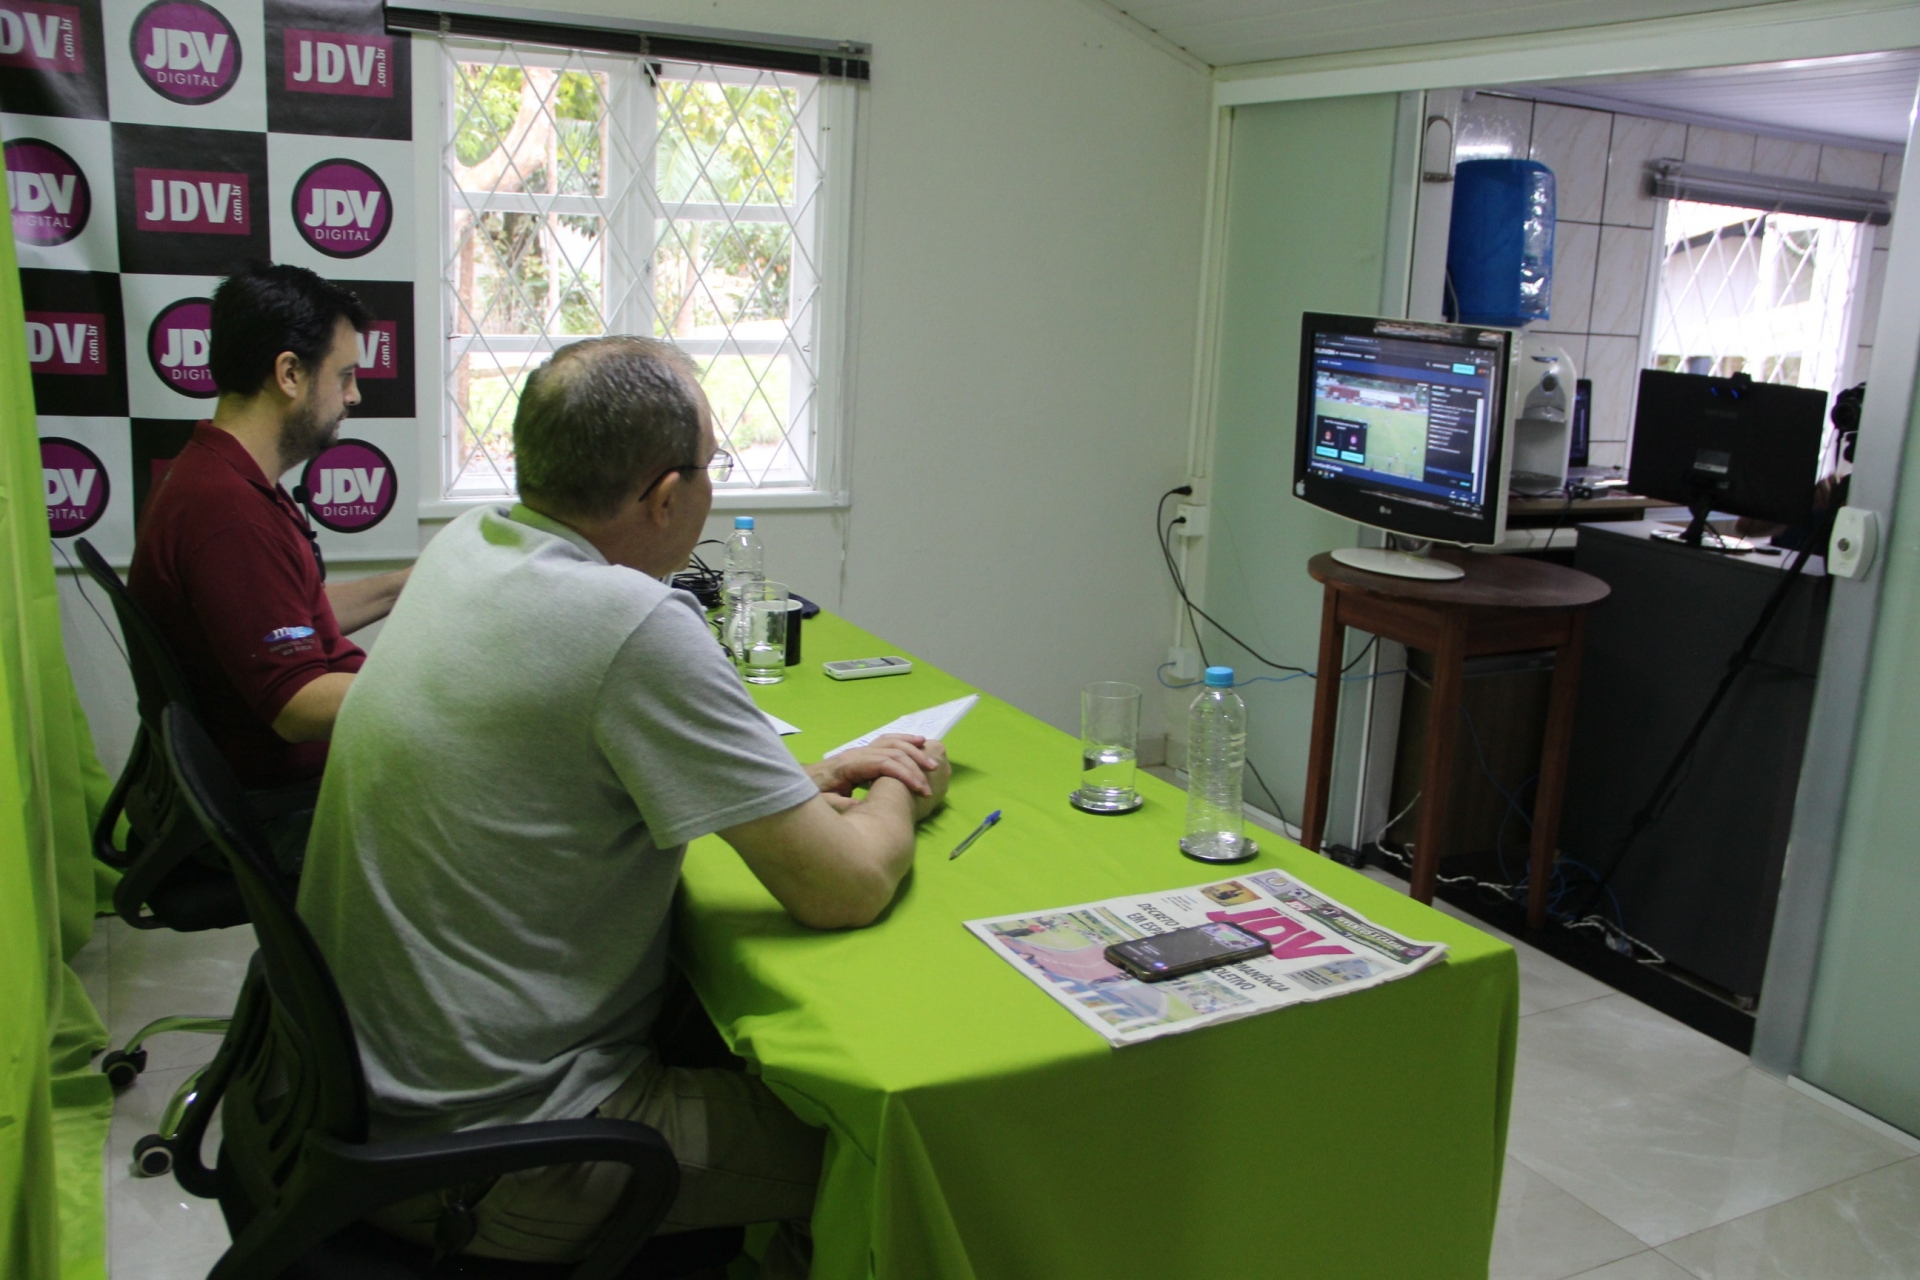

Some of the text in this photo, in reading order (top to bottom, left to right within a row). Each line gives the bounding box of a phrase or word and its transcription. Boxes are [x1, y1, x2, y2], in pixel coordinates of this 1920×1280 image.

[0, 9, 60, 59] DV
[60, 18, 75, 61] .com.br
[144, 27, 229, 73] JDV
[157, 71, 218, 88] DIGITAL
[293, 40, 377, 87] JDV
[375, 47, 387, 87] .com.br
[145, 179, 231, 224] JDV
[230, 183, 243, 224] .com.br
[304, 188, 382, 229] JDV
[315, 228, 371, 242] DIGITAL
[25, 321, 87, 364] DV
[86, 324, 100, 364] .com.br
[160, 328, 212, 368] JD
[379, 331, 391, 369] .com.br
[172, 369, 213, 381] DIGIT
[43, 468, 98, 507] DV
[313, 467, 386, 506] JDV
[46, 508, 87, 520] GITAL
[323, 505, 377, 517] DIGITAL
[1126, 912, 1148, 923] EM
[1139, 921, 1167, 935] ESPA
[1211, 966, 1256, 990] OLETIVO
[1137, 903, 1180, 926] DECRETO
[1232, 962, 1290, 991] RMANÊNCIA
[1206, 907, 1355, 960] JDV
